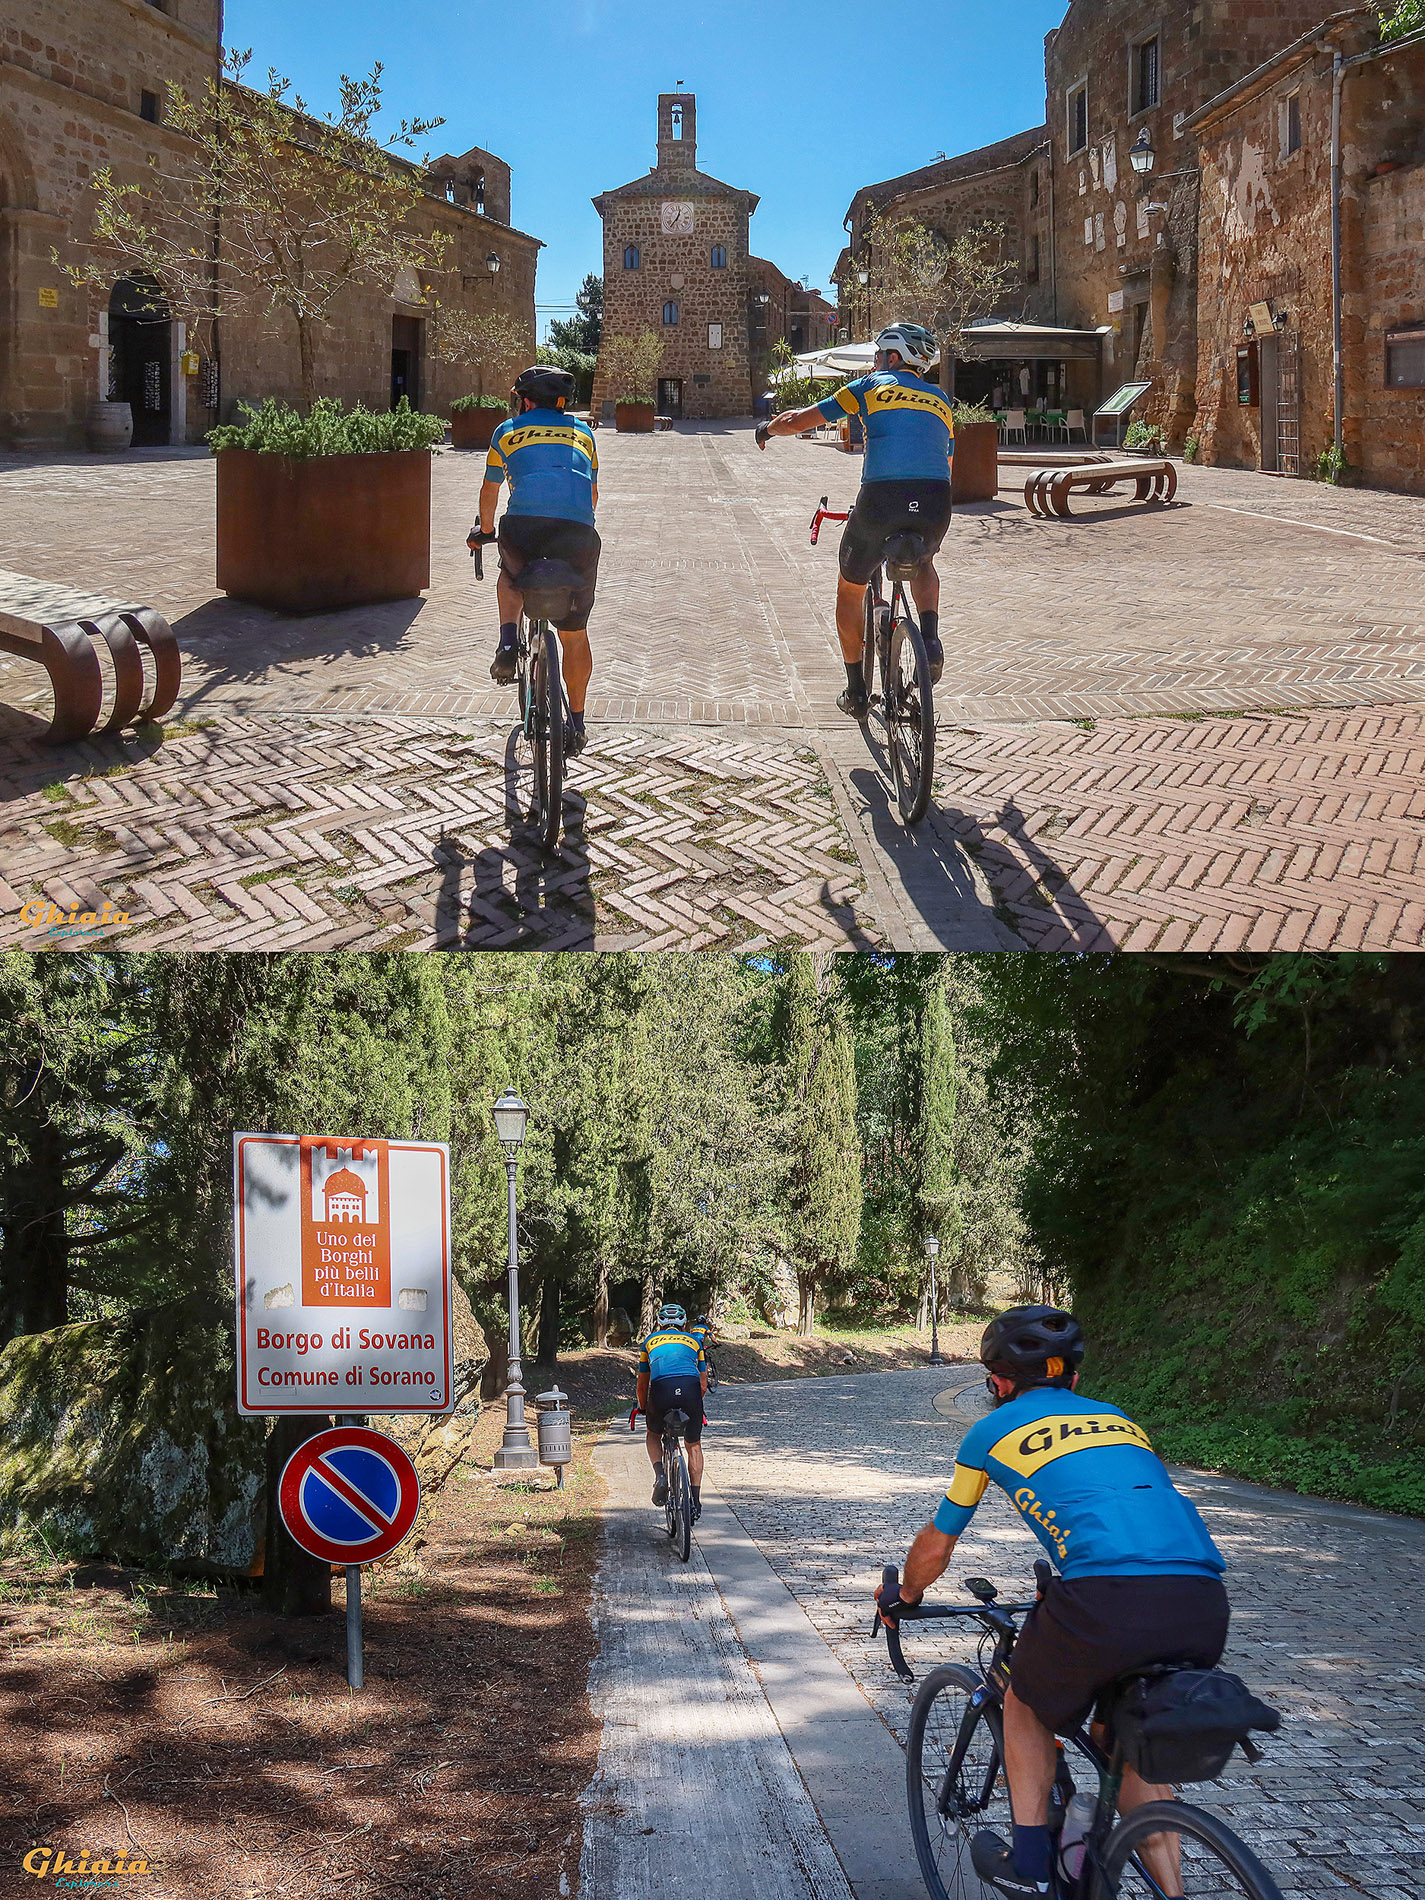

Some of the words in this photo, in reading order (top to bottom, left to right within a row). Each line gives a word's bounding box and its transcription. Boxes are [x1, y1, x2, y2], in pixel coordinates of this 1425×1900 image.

[876, 389, 949, 420] Ghiaia
[507, 429, 589, 452] Ghiaia
[316, 1231, 348, 1246] Uno
[352, 1232, 376, 1247] dei
[320, 1248, 373, 1267] Borghi
[314, 1265, 340, 1282] più
[345, 1266, 379, 1281] belli
[320, 1282, 376, 1298] d'Italia
[256, 1327, 324, 1355] Borgo
[331, 1326, 350, 1350] di
[358, 1328, 435, 1350] Sovana
[257, 1366, 339, 1386] Comune
[345, 1365, 363, 1386] di
[369, 1366, 436, 1386] Sorano
